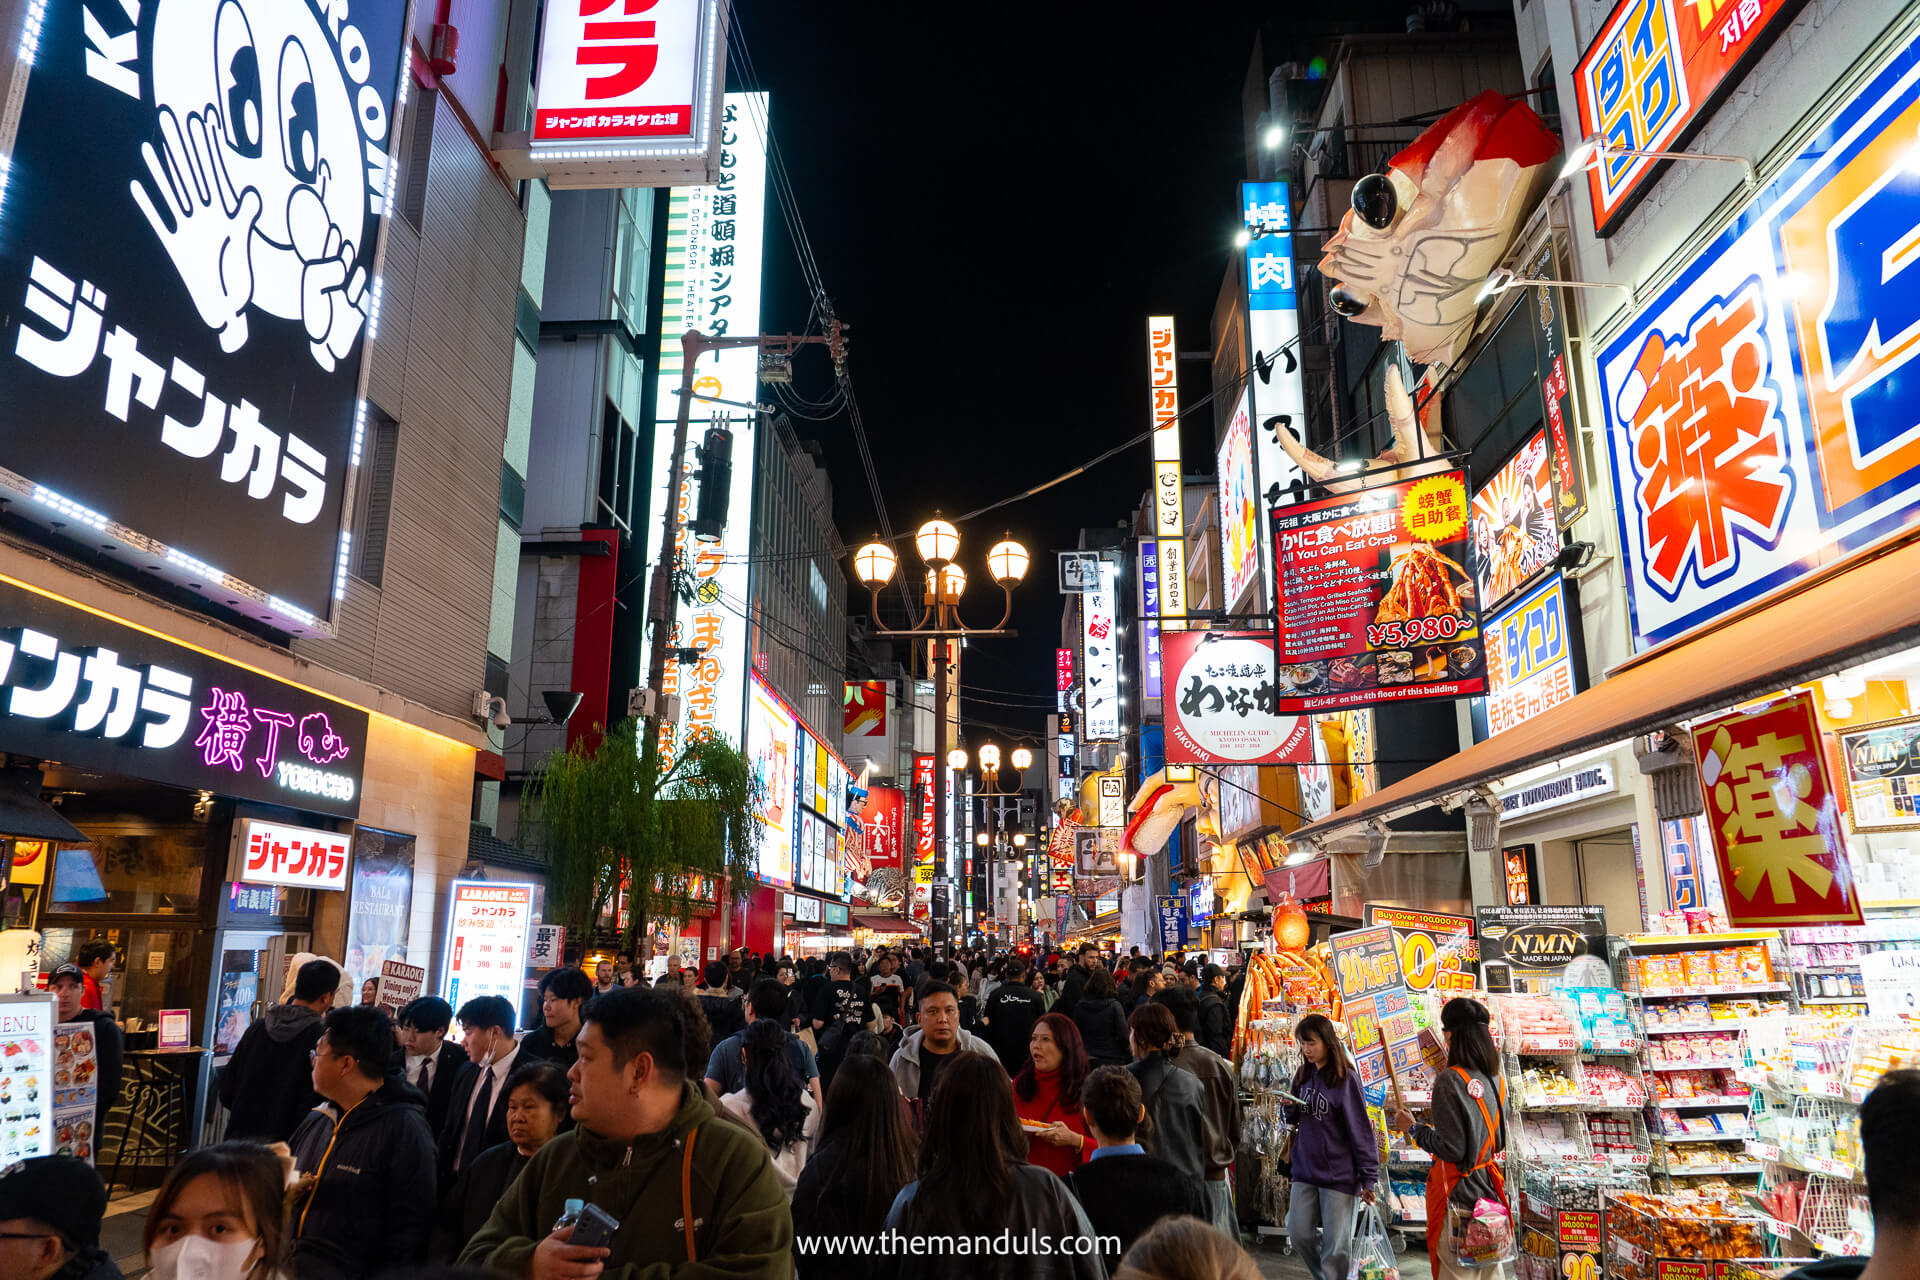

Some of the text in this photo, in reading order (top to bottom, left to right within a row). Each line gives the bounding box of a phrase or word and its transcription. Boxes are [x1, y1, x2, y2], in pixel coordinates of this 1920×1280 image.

[576, 0, 660, 100] ラ
[546, 112, 679, 129] ジャンボカラオケ広場
[1244, 202, 1293, 291] 焼肉
[684, 208, 700, 328] DOTONBORI THEATER
[15, 255, 328, 524] ジャンカラ
[1152, 328, 1176, 431] ジャンカラ
[1620, 296, 1784, 584] 薬
[1418, 488, 1453, 509] 螃蟹
[1279, 517, 1299, 530] 元祖
[1412, 505, 1462, 529] 自助餐
[1282, 534, 1398, 564] All You Can Eat Crab
[1166, 547, 1180, 609] 創業昭和四年
[1506, 594, 1563, 681] ダイコク
[1339, 696, 1349, 704] on
[1350, 693, 1363, 702] the
[1363, 691, 1376, 700] 4th
[1377, 689, 1396, 699] floor
[1397, 688, 1407, 696] of
[1407, 686, 1423, 696] this
[1423, 684, 1459, 695] building
[195, 687, 296, 778] 横丁
[1172, 724, 1210, 762] TAKOYAKI
[1276, 725, 1308, 760] WANAKA
[1855, 741, 1900, 766] NMN
[277, 760, 356, 802] YOKOCHO
[1701, 724, 1836, 905] 薬
[247, 832, 346, 880] ジャンカラ
[461, 889, 509, 902] KARAOKE
[1377, 910, 1394, 920] Buy
[1396, 913, 1416, 922] Over
[1419, 915, 1451, 926] 100,000
[1452, 919, 1468, 928] Yen
[535, 927, 551, 958] 最安
[1508, 934, 1581, 954] NMN
[390, 962, 424, 983] KARAOKE
[1435, 970, 1476, 990] OFF
[383, 979, 418, 998] Dining only?
[0, 1016, 38, 1034] ENU
[1558, 1039, 1574, 1048] 598
[1619, 1039, 1636, 1048] 648
[1826, 1081, 1841, 1095] 198
[1626, 1096, 1642, 1106] 598
[1631, 1154, 1648, 1164] 698
[1561, 1221, 1585, 1230] 100,000
[1564, 1213, 1577, 1222] Buy
[1666, 1264, 1701, 1274] Buy Over
